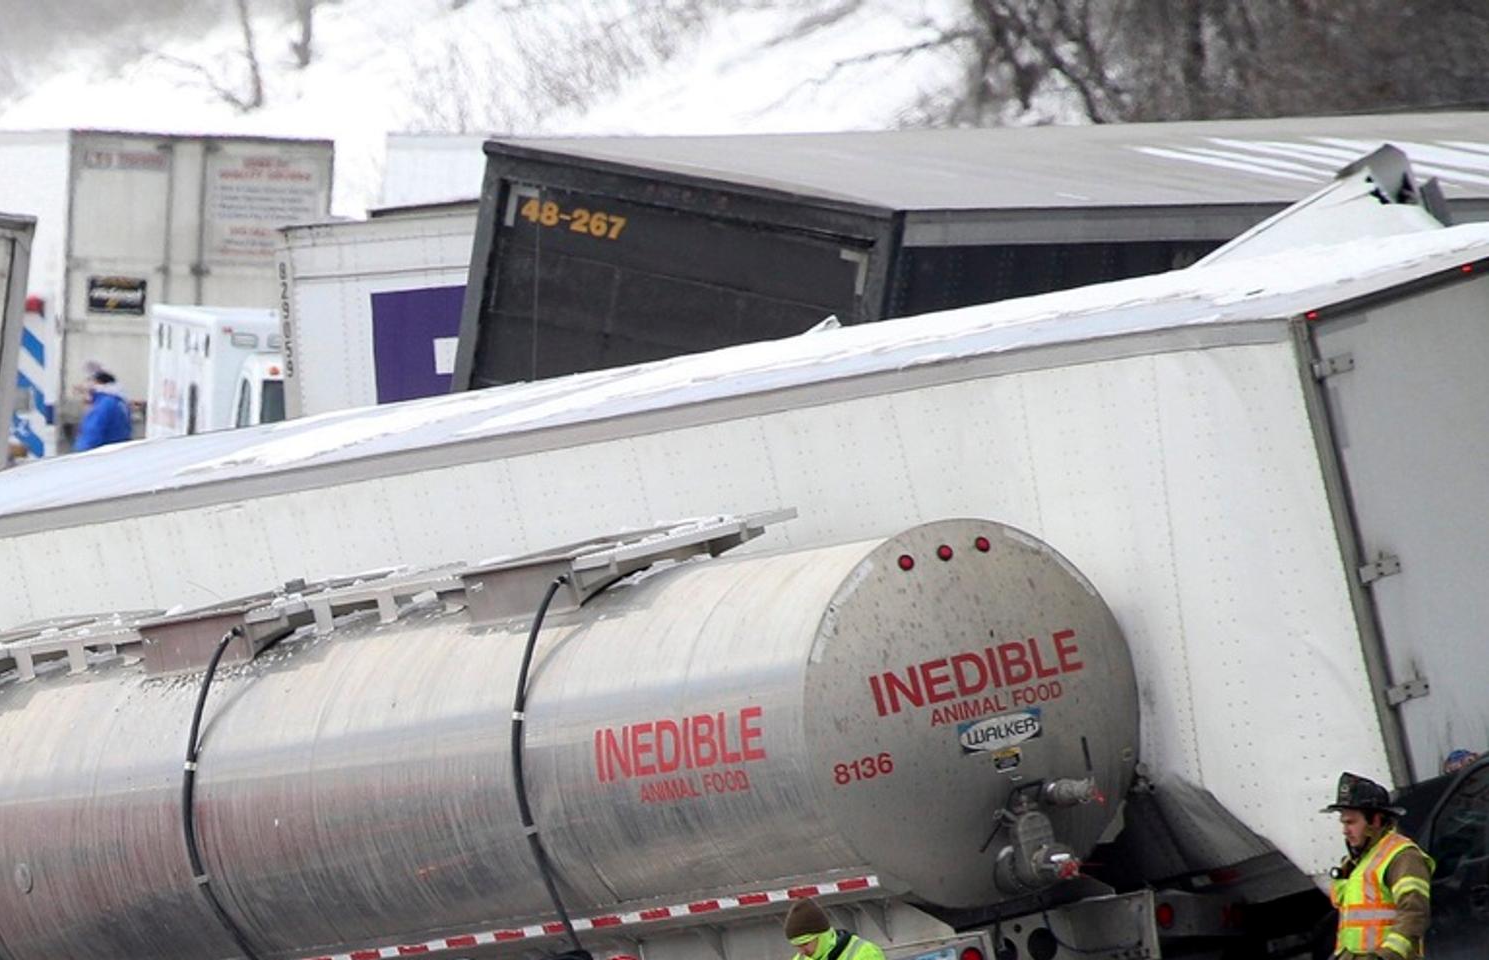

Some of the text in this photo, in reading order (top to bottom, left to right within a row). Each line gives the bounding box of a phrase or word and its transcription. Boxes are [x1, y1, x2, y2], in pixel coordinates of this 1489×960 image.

[520, 198, 627, 240] 48-267
[868, 629, 1084, 717] INEDIBLE
[930, 681, 1063, 727] ANIMAL FOOD
[594, 705, 767, 784] INEDIBLE
[967, 718, 1037, 746] WALKER
[640, 768, 752, 804] ANIMAL FOOD
[833, 752, 894, 786] 8136
